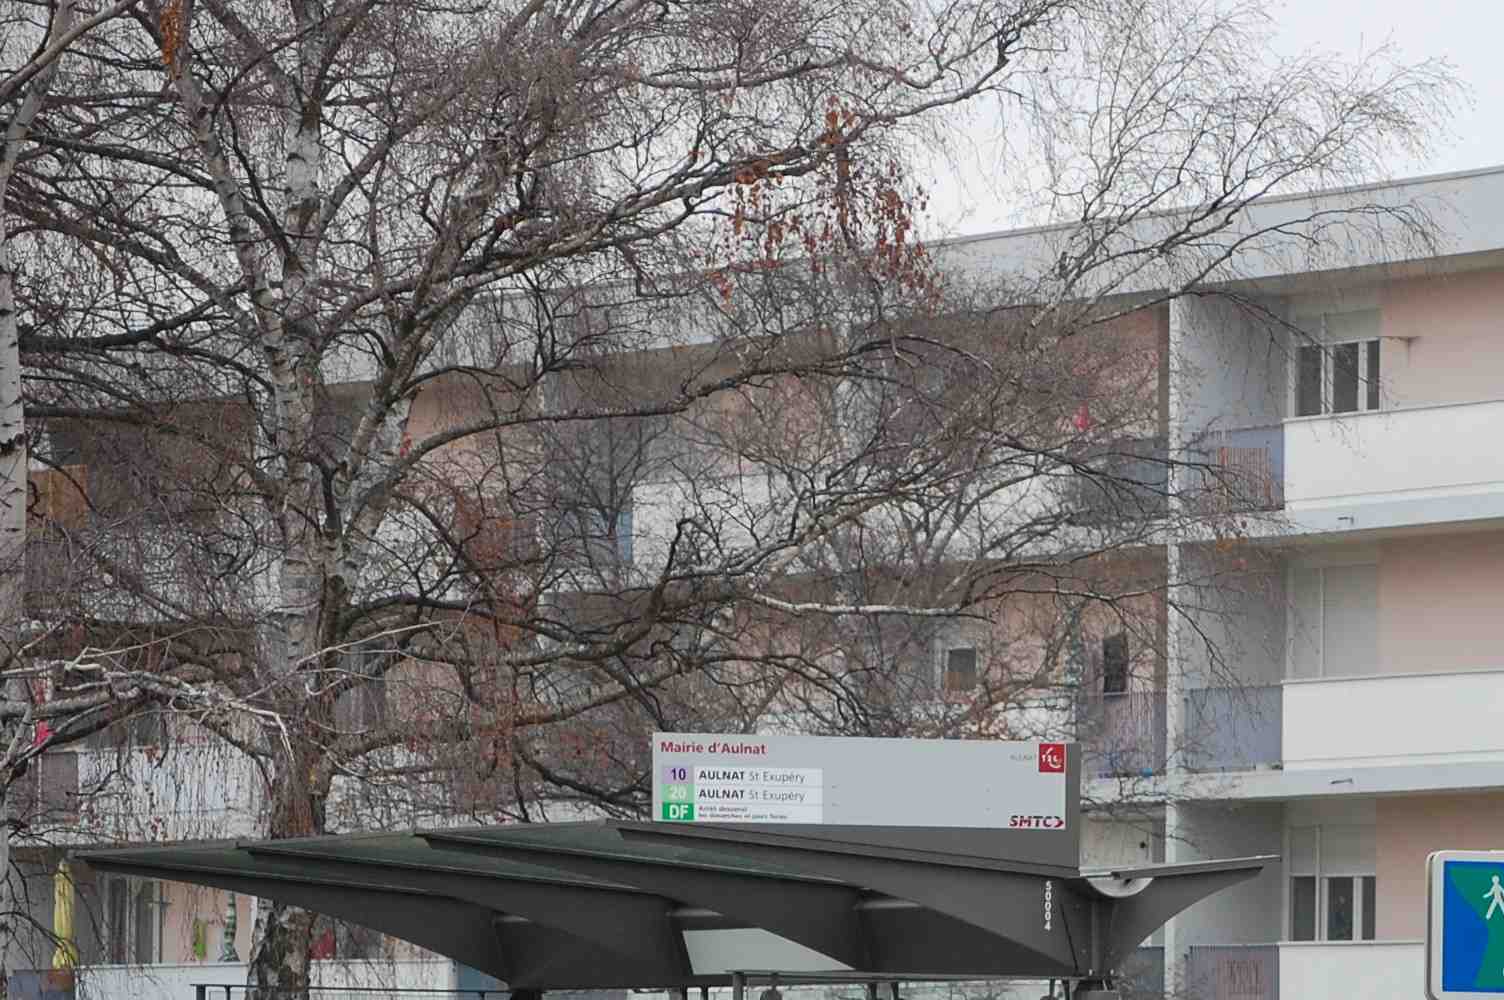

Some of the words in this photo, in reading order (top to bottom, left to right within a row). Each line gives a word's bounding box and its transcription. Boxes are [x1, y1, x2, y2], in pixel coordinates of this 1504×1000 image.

[660, 741, 704, 753] Mairie
[708, 742, 768, 755] d'Aulnat
[670, 768, 686, 781] 10
[698, 770, 745, 781] AULNAT
[749, 772, 759, 782] St
[763, 771, 805, 784] Exupéry
[670, 785, 687, 799] 20
[698, 789, 745, 800] AULNAT
[749, 791, 759, 801] St
[763, 790, 805, 802] Exupéry
[669, 804, 689, 819] DF
[1009, 815, 1053, 828] SMTC
